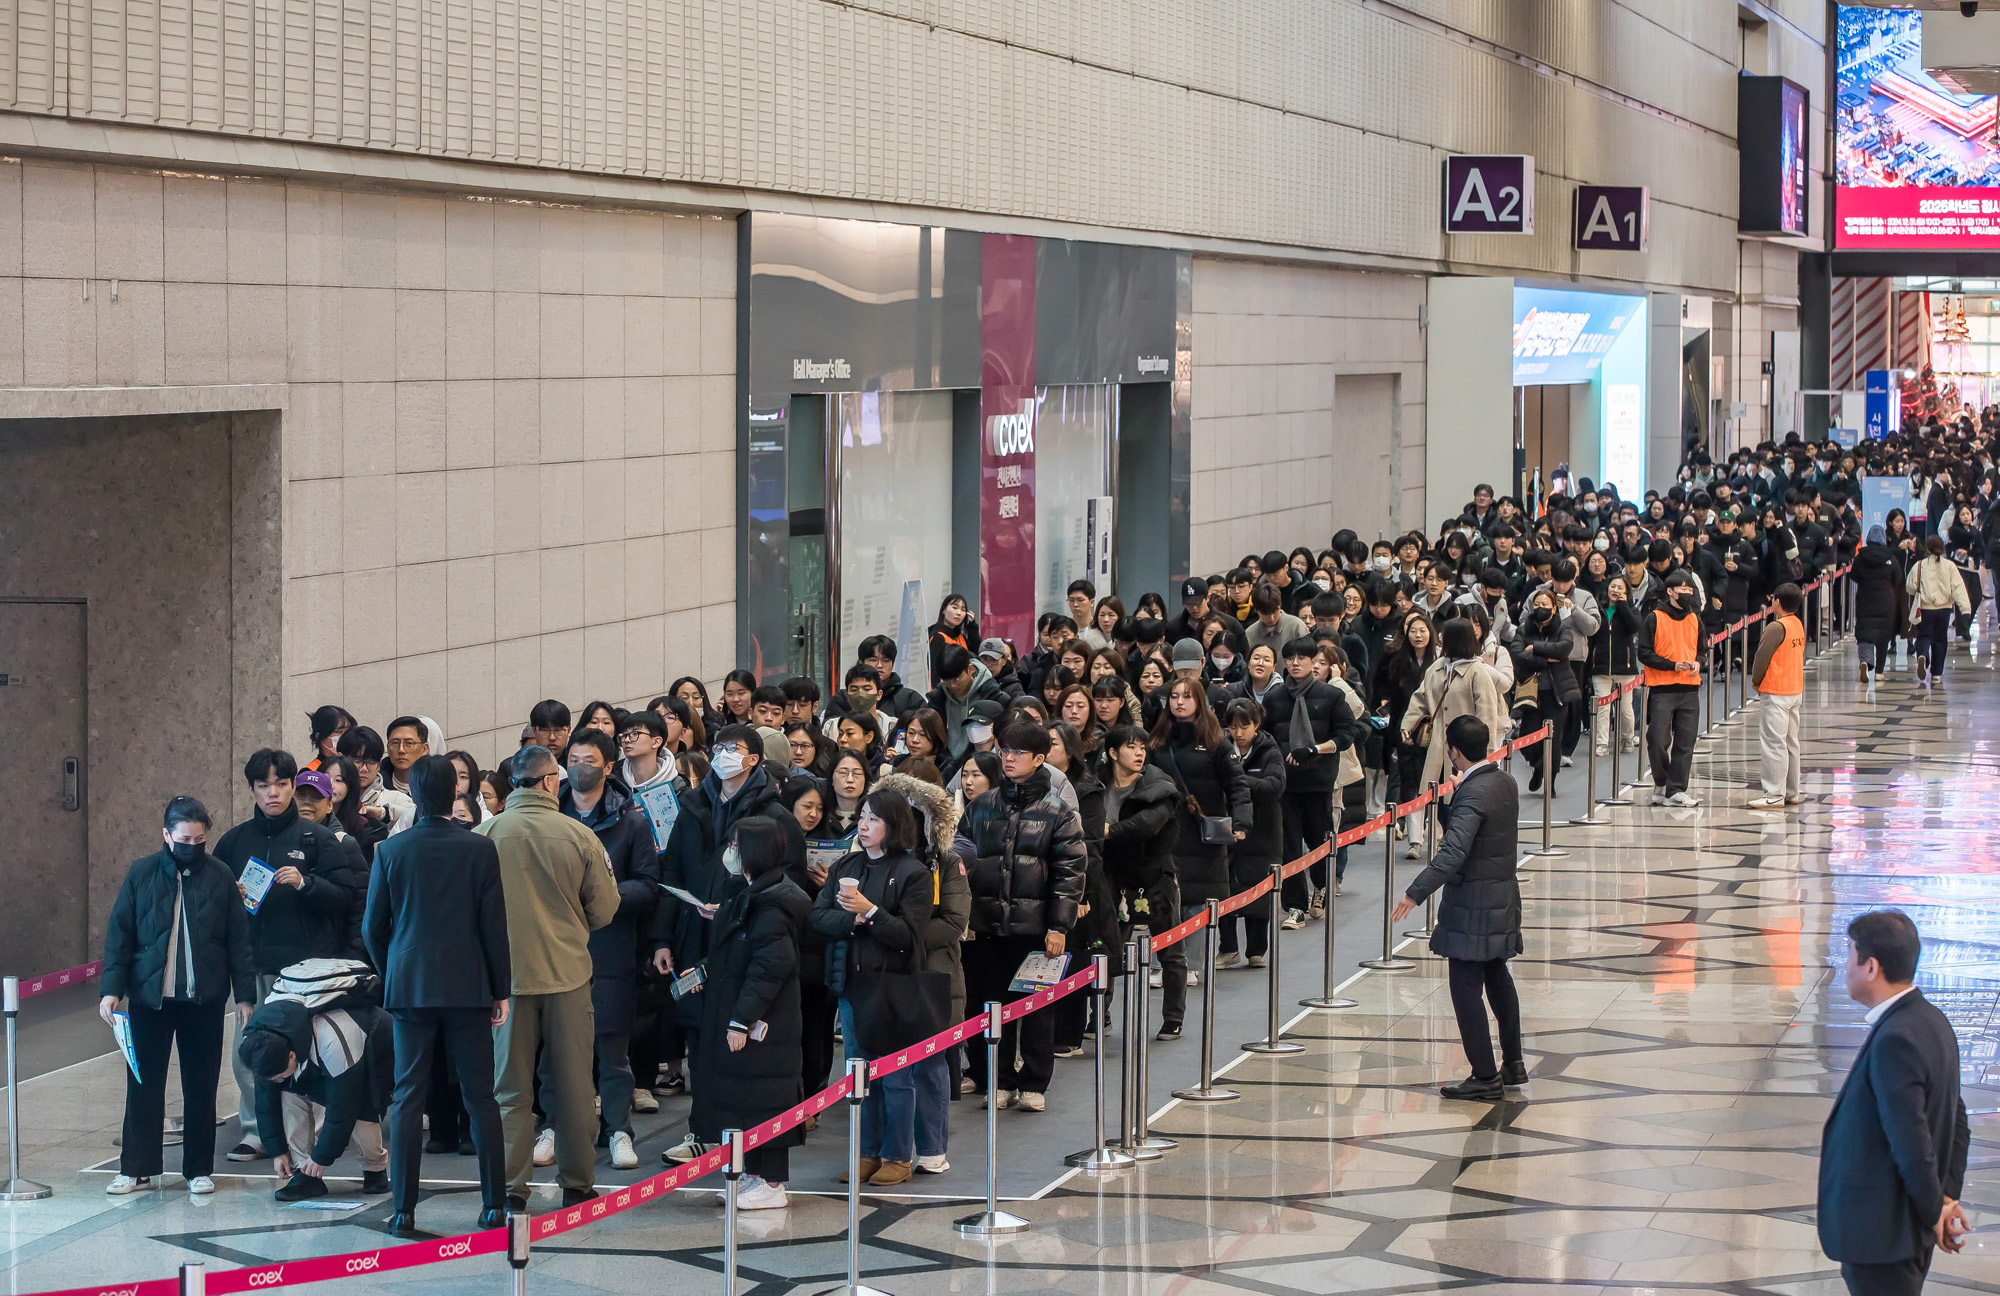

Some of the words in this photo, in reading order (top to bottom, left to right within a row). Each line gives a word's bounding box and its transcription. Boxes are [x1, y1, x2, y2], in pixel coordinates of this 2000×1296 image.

[1452, 168, 1520, 222] A2
[1582, 195, 1636, 242] A1
[794, 358, 805, 379] Hall
[806, 358, 834, 384] Manager's
[834, 358, 851, 379] Office
[1000, 398, 1035, 457] coex
[32, 979, 42, 992] coex
[60, 972, 70, 984] coex
[86, 964, 96, 977] coex
[869, 1062, 878, 1077] oex
[897, 1050, 908, 1067] coex
[925, 1038, 936, 1054] coex
[953, 1025, 964, 1041] coex
[980, 1013, 990, 1028] coex
[749, 1127, 759, 1146] coex
[772, 1115, 782, 1134] coex
[795, 1104, 804, 1122] coex
[816, 1093, 826, 1109] coex
[837, 1079, 847, 1096] coex
[542, 1214, 557, 1234] coex
[567, 1206, 582, 1226] coex
[592, 1197, 607, 1217] coex
[616, 1188, 631, 1208] coex
[640, 1179, 654, 1199] coex
[664, 1169, 678, 1189] coex
[687, 1160, 701, 1179] coex
[709, 1150, 722, 1169] coex
[249, 1265, 284, 1287] coex
[346, 1250, 380, 1273] coex
[439, 1236, 472, 1258] coex
